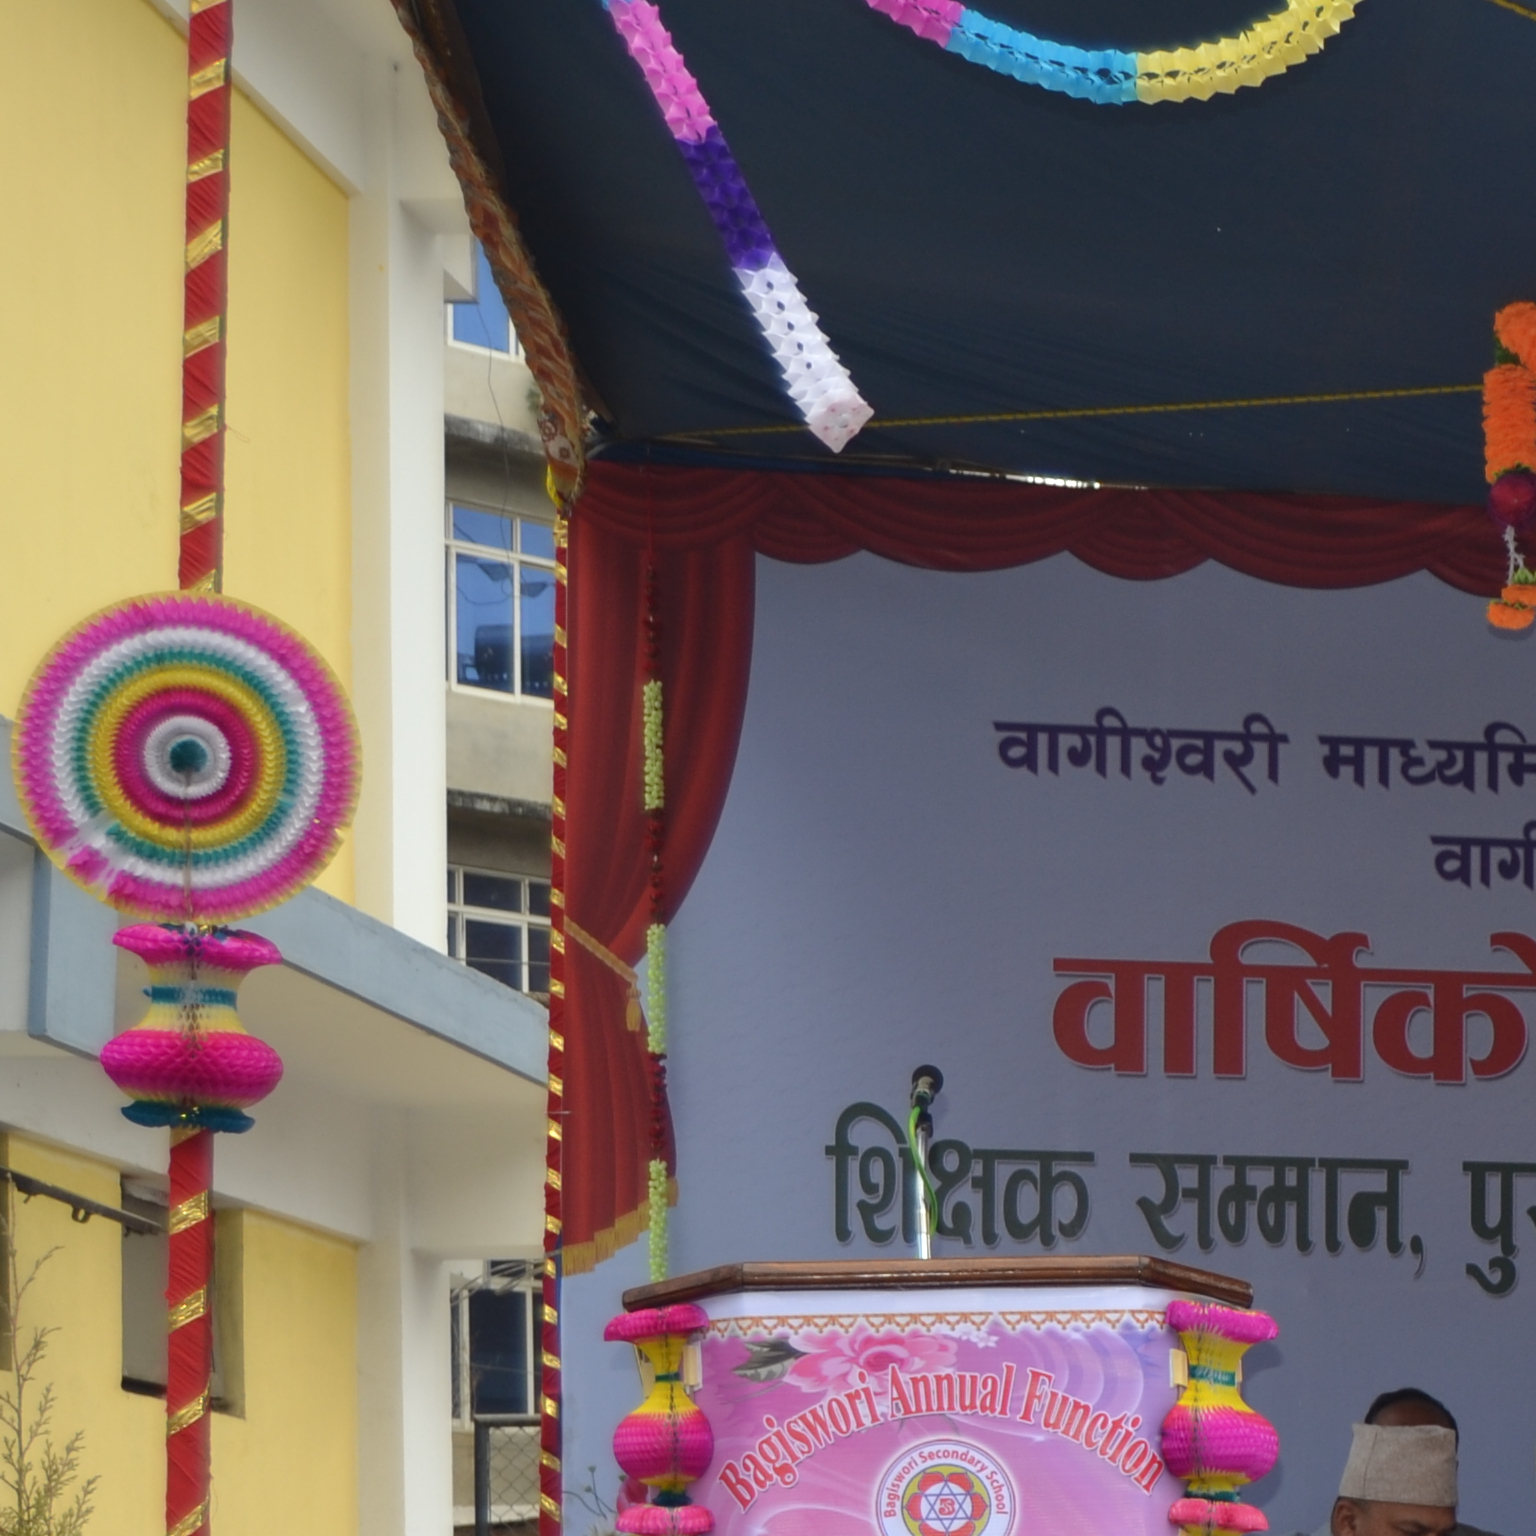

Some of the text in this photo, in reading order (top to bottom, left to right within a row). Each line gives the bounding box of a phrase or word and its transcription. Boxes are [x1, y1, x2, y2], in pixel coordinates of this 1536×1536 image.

[993, 707, 1289, 795] वागीश्वरी
[825, 1101, 1096, 1248] शिक्षक
[1129, 1152, 1425, 1268] सम्मान,
[718, 1363, 1167, 1513] Bagiswori Annual Function
[884, 1449, 1009, 1518] Bagiswori Secondary School
